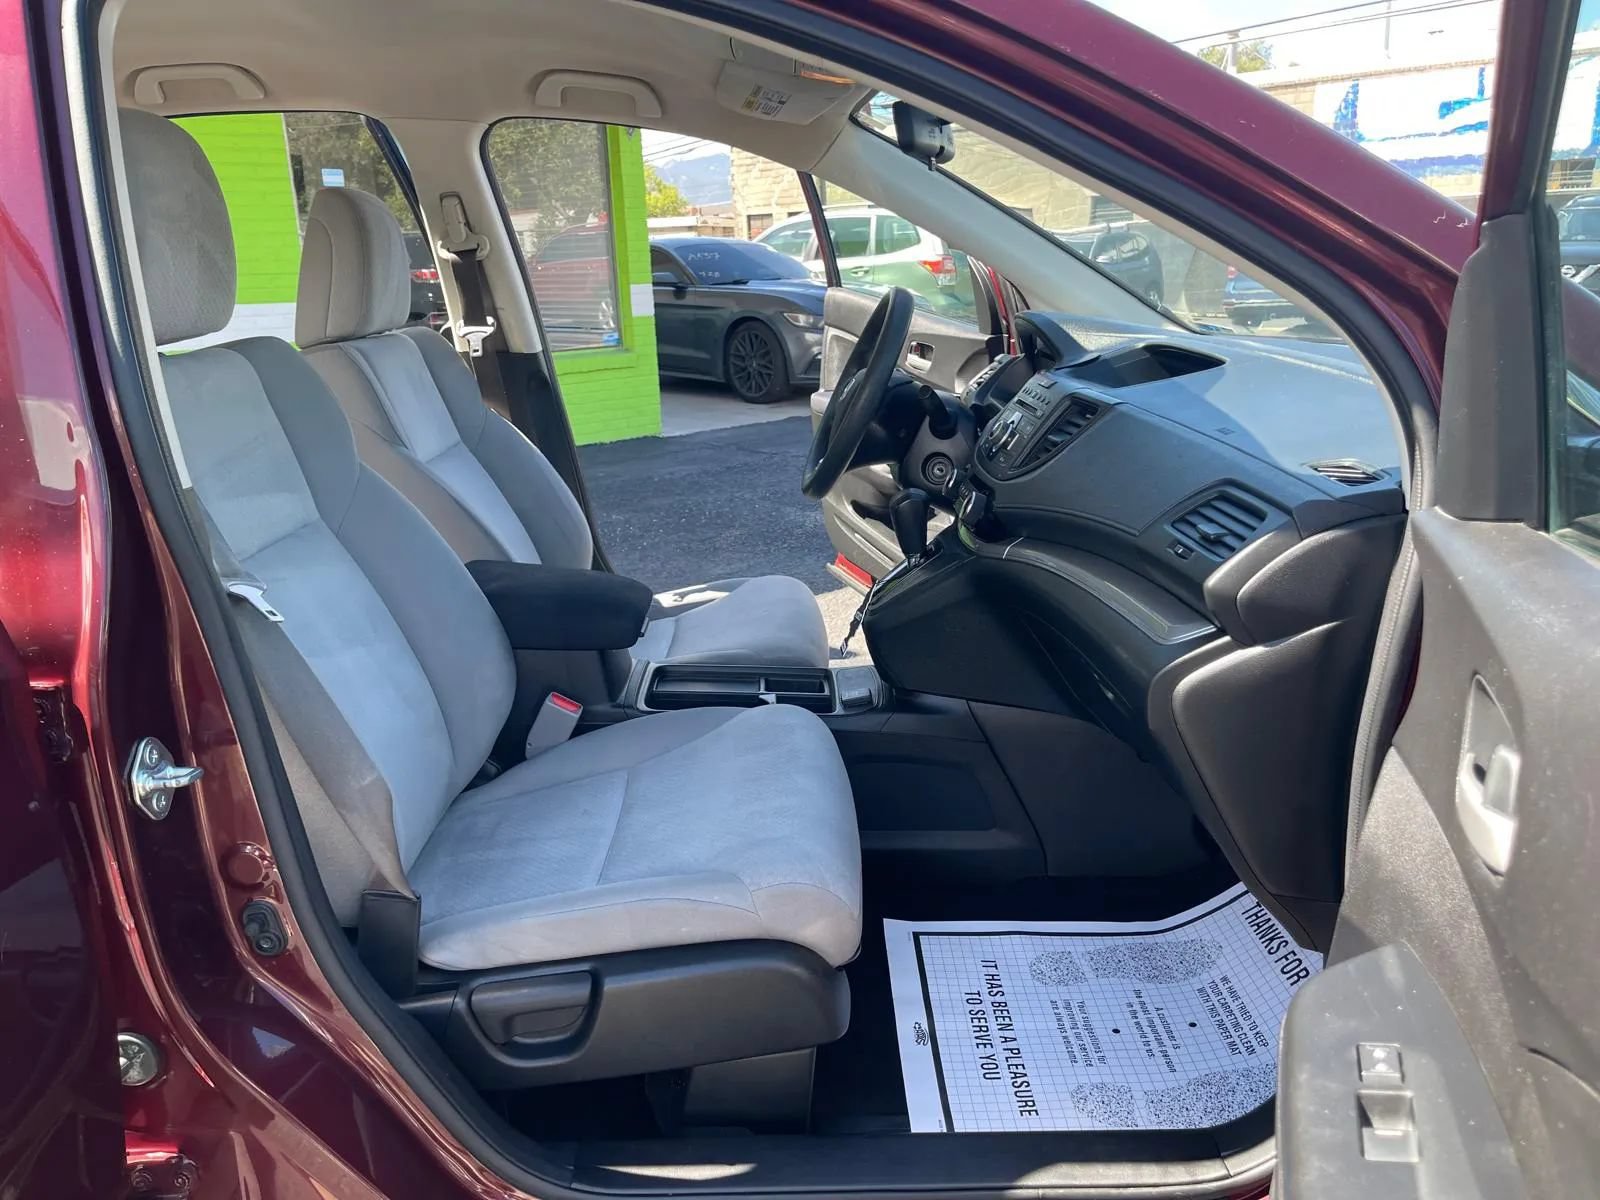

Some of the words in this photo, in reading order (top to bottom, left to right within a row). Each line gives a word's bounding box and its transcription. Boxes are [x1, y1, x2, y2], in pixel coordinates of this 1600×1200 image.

[1241, 901, 1289, 955] THANKS
[1274, 950, 1310, 987] FOR
[980, 960, 998, 970] IT
[984, 973, 1005, 997] HAS
[1219, 975, 1231, 987] WE
[964, 990, 983, 1005] TO
[1050, 1000, 1059, 1011] are
[1225, 985, 1241, 1004] HAVE
[991, 1001, 1015, 1032] BEEN
[1063, 999, 1079, 1030] improving
[1076, 1000, 1087, 1015] Your
[1207, 979, 1223, 998] YOUR
[1217, 997, 1243, 1033] CARPETING
[1237, 1031, 1257, 1056] CLEAN
[1236, 1000, 1253, 1022] TRIED
[968, 1009, 993, 1049] SERVE
[1054, 1011, 1067, 1034] always
[1128, 1009, 1138, 1020] the
[1133, 1020, 1149, 1039] world
[1141, 1040, 1151, 1048] to
[1132, 989, 1142, 999] the
[1138, 1000, 1151, 1016] most
[1145, 1016, 1167, 1048] important
[1157, 1049, 1177, 1073] person
[1157, 1012, 1177, 1042] customer
[1197, 986, 1211, 1004] WITH
[1205, 1002, 1219, 1019] THIS
[1214, 1016, 1233, 1041] PAPER
[1226, 1036, 1242, 1056] MAT
[1246, 1018, 1259, 1031] TO
[1000, 1035, 1017, 1044] A
[1074, 1031, 1083, 1042] our
[1081, 1016, 1102, 1054] suggestions
[1252, 1027, 1269, 1048] KEEP
[979, 1053, 1001, 1081] YOU
[1078, 1043, 1094, 1067] service
[1096, 1055, 1107, 1065] for
[1003, 1047, 1039, 1117] PLEASURE
